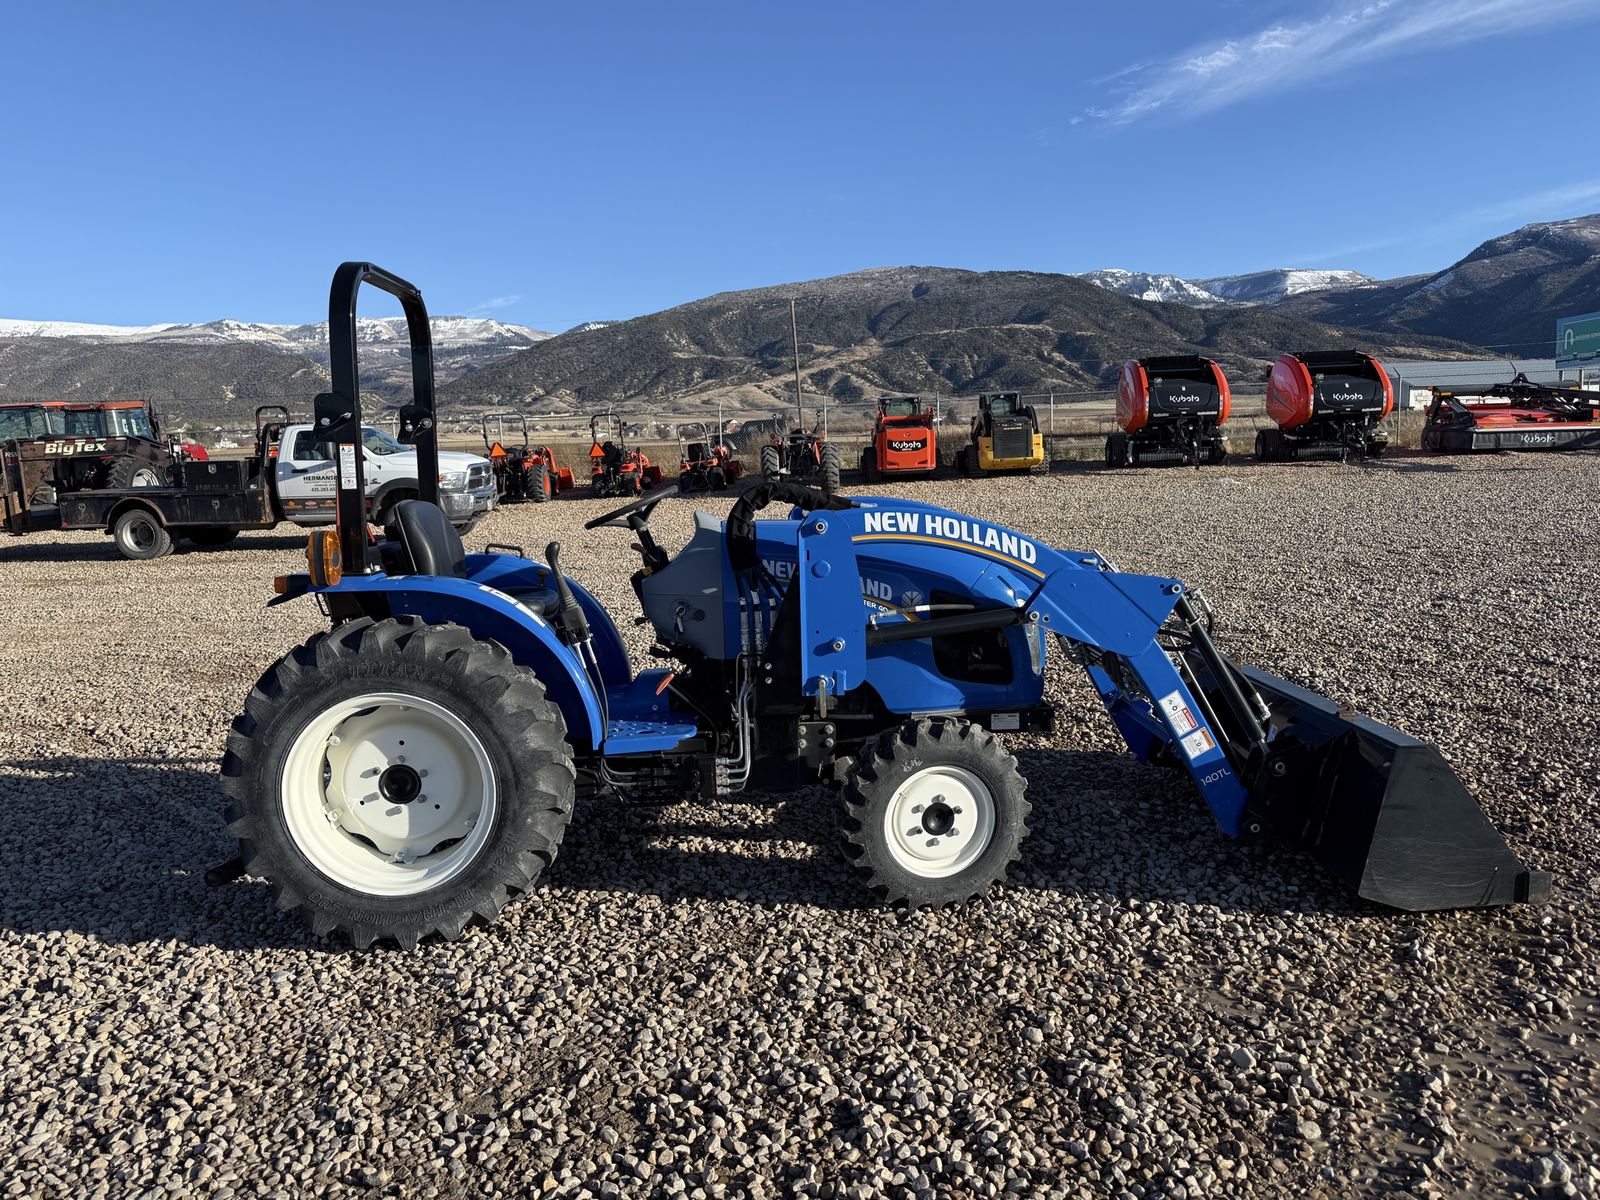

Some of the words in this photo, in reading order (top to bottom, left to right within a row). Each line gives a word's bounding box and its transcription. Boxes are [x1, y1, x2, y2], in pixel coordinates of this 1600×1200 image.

[1169, 395, 1200, 403] Kubota
[1332, 392, 1363, 400] Kubota
[1520, 434, 1555, 443] Kubota
[44, 442, 106, 456] BigTex
[892, 440, 922, 449] Kubota
[864, 512, 919, 532] NEW
[925, 514, 1037, 565] HOLLAND
[1201, 768, 1230, 786] 140TL
[307, 890, 345, 914] LUG
